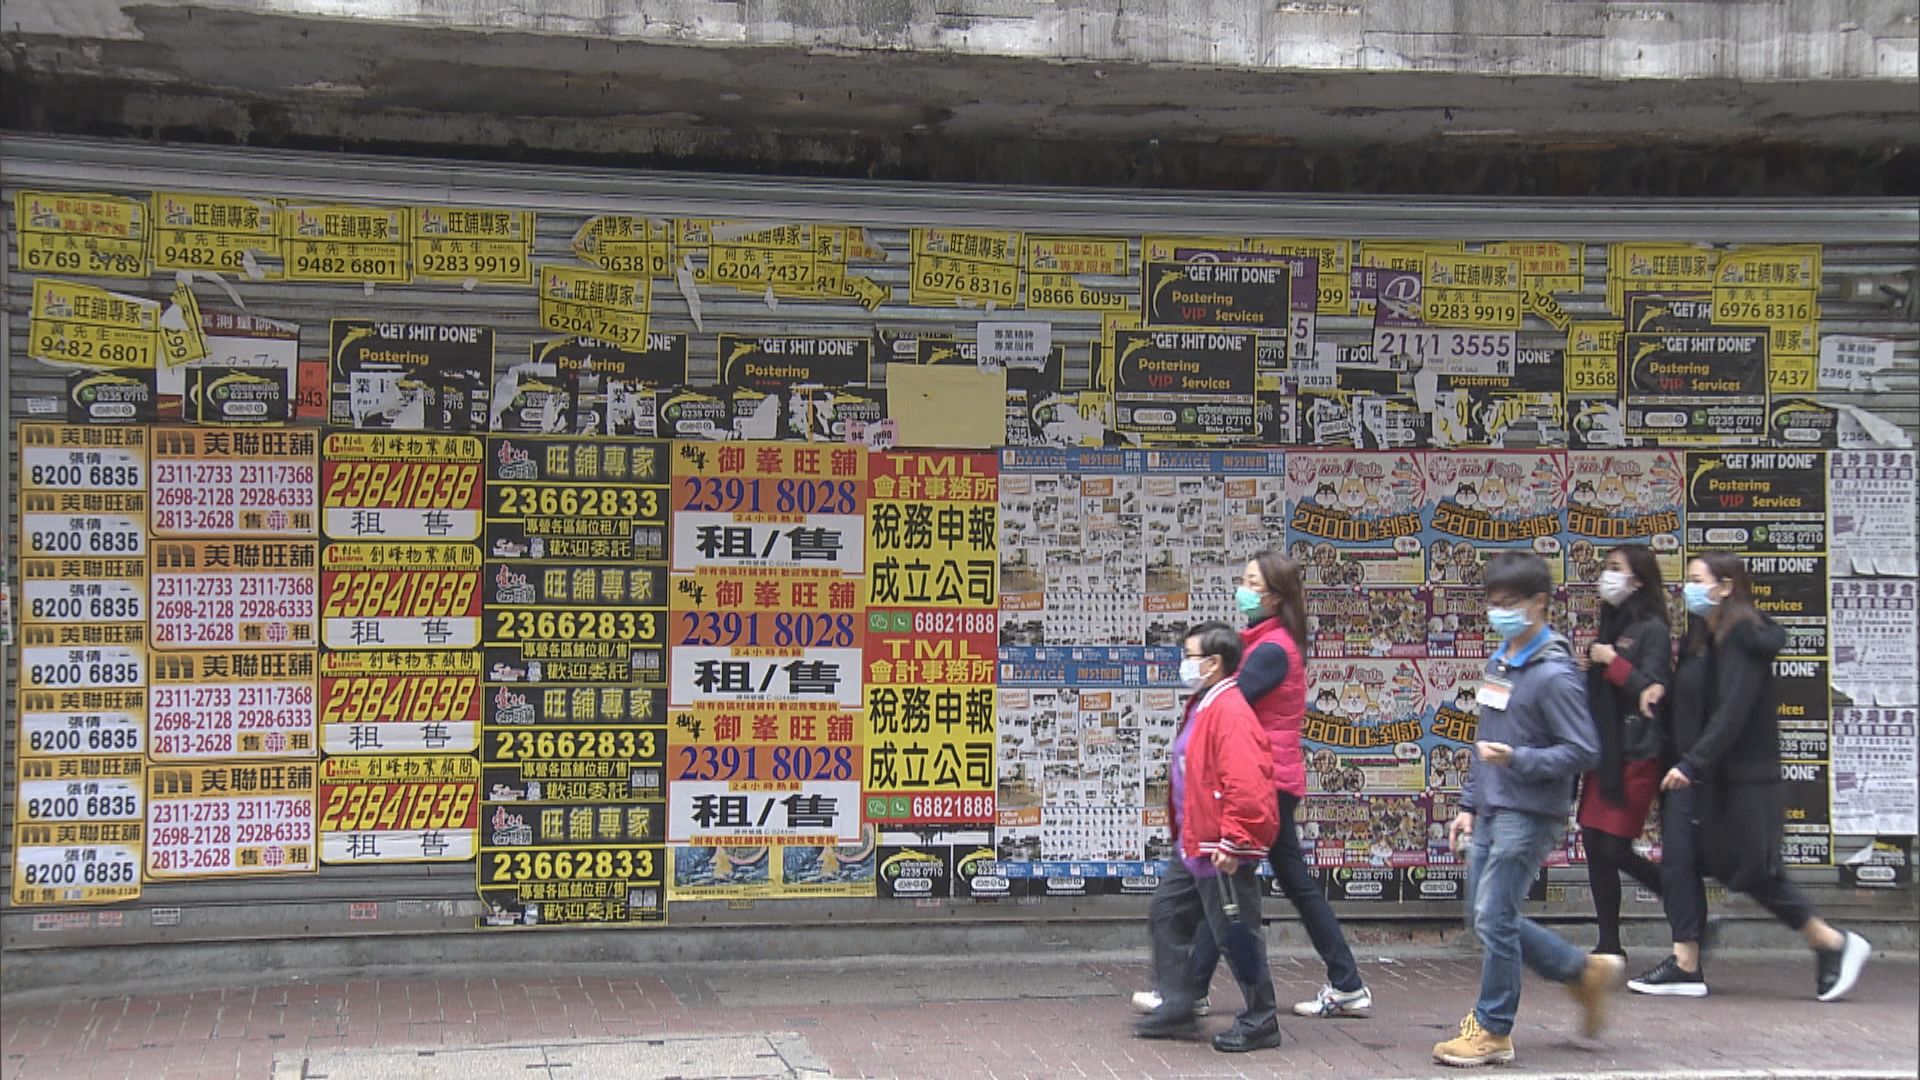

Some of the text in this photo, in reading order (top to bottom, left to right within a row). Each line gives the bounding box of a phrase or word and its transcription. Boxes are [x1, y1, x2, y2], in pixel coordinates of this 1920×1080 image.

[28, 250, 81, 267] 6769
[165, 246, 214, 266] 9482
[297, 257, 396, 276] 9482 6801
[422, 255, 520, 273] 9283 9919
[599, 256, 644, 272] 9638
[717, 262, 809, 281] 6204 7437
[1215, 267, 1239, 282] SHIT
[922, 271, 1012, 296] 6976 8316
[1031, 288, 1074, 305] 9866
[1171, 291, 1234, 306] Postering
[1182, 307, 1264, 323] VIP Services
[1429, 303, 1515, 322] 9283 9919
[1719, 303, 1808, 319] 6976 8316
[408, 324, 436, 341] SHIT
[548, 314, 641, 344] 6204 7437
[40, 335, 149, 364] 9482 6801
[1181, 334, 1205, 350] SHIT
[1379, 331, 1511, 357] 2111 3555
[359, 348, 430, 366] Postering
[1138, 358, 1201, 373] Postering
[1148, 374, 1232, 390] VIP Services
[1574, 371, 1617, 386] 9368
[1821, 367, 1852, 380] 2366
[1198, 415, 1252, 427] 6235 0710
[62, 428, 144, 445] 美聯旺舖
[203, 432, 315, 456] 美聯旺舖
[546, 445, 655, 478] 旺舖專家
[885, 454, 985, 476] TML
[1751, 454, 1775, 469] SHIT
[31, 465, 139, 486] 8200 6835
[156, 465, 314, 484] 2311-2733 2311-7368
[325, 463, 479, 510] 23841838
[684, 477, 857, 514] 2391 8028
[872, 475, 997, 499] 會計事務所
[1709, 480, 1770, 493] Postering
[61, 494, 144, 511] 美聯旺舖
[156, 488, 314, 507] 2698-2128 2928-6333
[499, 487, 658, 516] 23662833
[1751, 495, 1802, 508] Services
[156, 510, 312, 530] 2813-2628 售 租
[871, 503, 996, 551] 稅務申報
[31, 532, 139, 551] 8200 6835
[548, 539, 631, 559] 歡迎委託
[695, 525, 844, 561] 租/售
[1751, 557, 1775, 572] SHIT
[544, 568, 654, 601] 旺舖專家
[870, 559, 995, 605] 成立公司
[323, 572, 478, 618] 23841838
[497, 611, 656, 640] 23662833
[914, 612, 995, 634] 68821888
[61, 627, 144, 643] 美聯旺舖
[882, 639, 981, 660] TML
[31, 663, 138, 685] 8200 6835
[546, 662, 629, 680] 歡迎委託
[869, 660, 995, 684] 會計事務所
[321, 677, 476, 722] 23841838
[543, 688, 654, 720] 旺舖專家
[869, 687, 994, 735] 稅務申報
[496, 731, 656, 760] 23662833
[59, 758, 142, 777] 美聯旺舖
[679, 746, 853, 781] 2391 8028
[868, 741, 993, 790] 成立公司
[200, 766, 313, 792] 美聯旺舖
[546, 781, 628, 800] 歡迎委託
[28, 796, 136, 819] 8200 6835
[153, 800, 312, 823] 2311-2733 2311-7368
[320, 783, 475, 832] 23841838
[691, 794, 840, 830] 租/售
[912, 796, 994, 818] 68821888
[57, 824, 140, 842] 美聯旺舖
[152, 823, 311, 846] 2698-2128 2928-6333
[540, 808, 651, 840] 旺舖專家
[152, 846, 308, 870] 2813-2628 售 租
[492, 850, 654, 880] 23662833
[25, 862, 133, 885] 8200 6835
[543, 903, 625, 921] 歡迎委託
